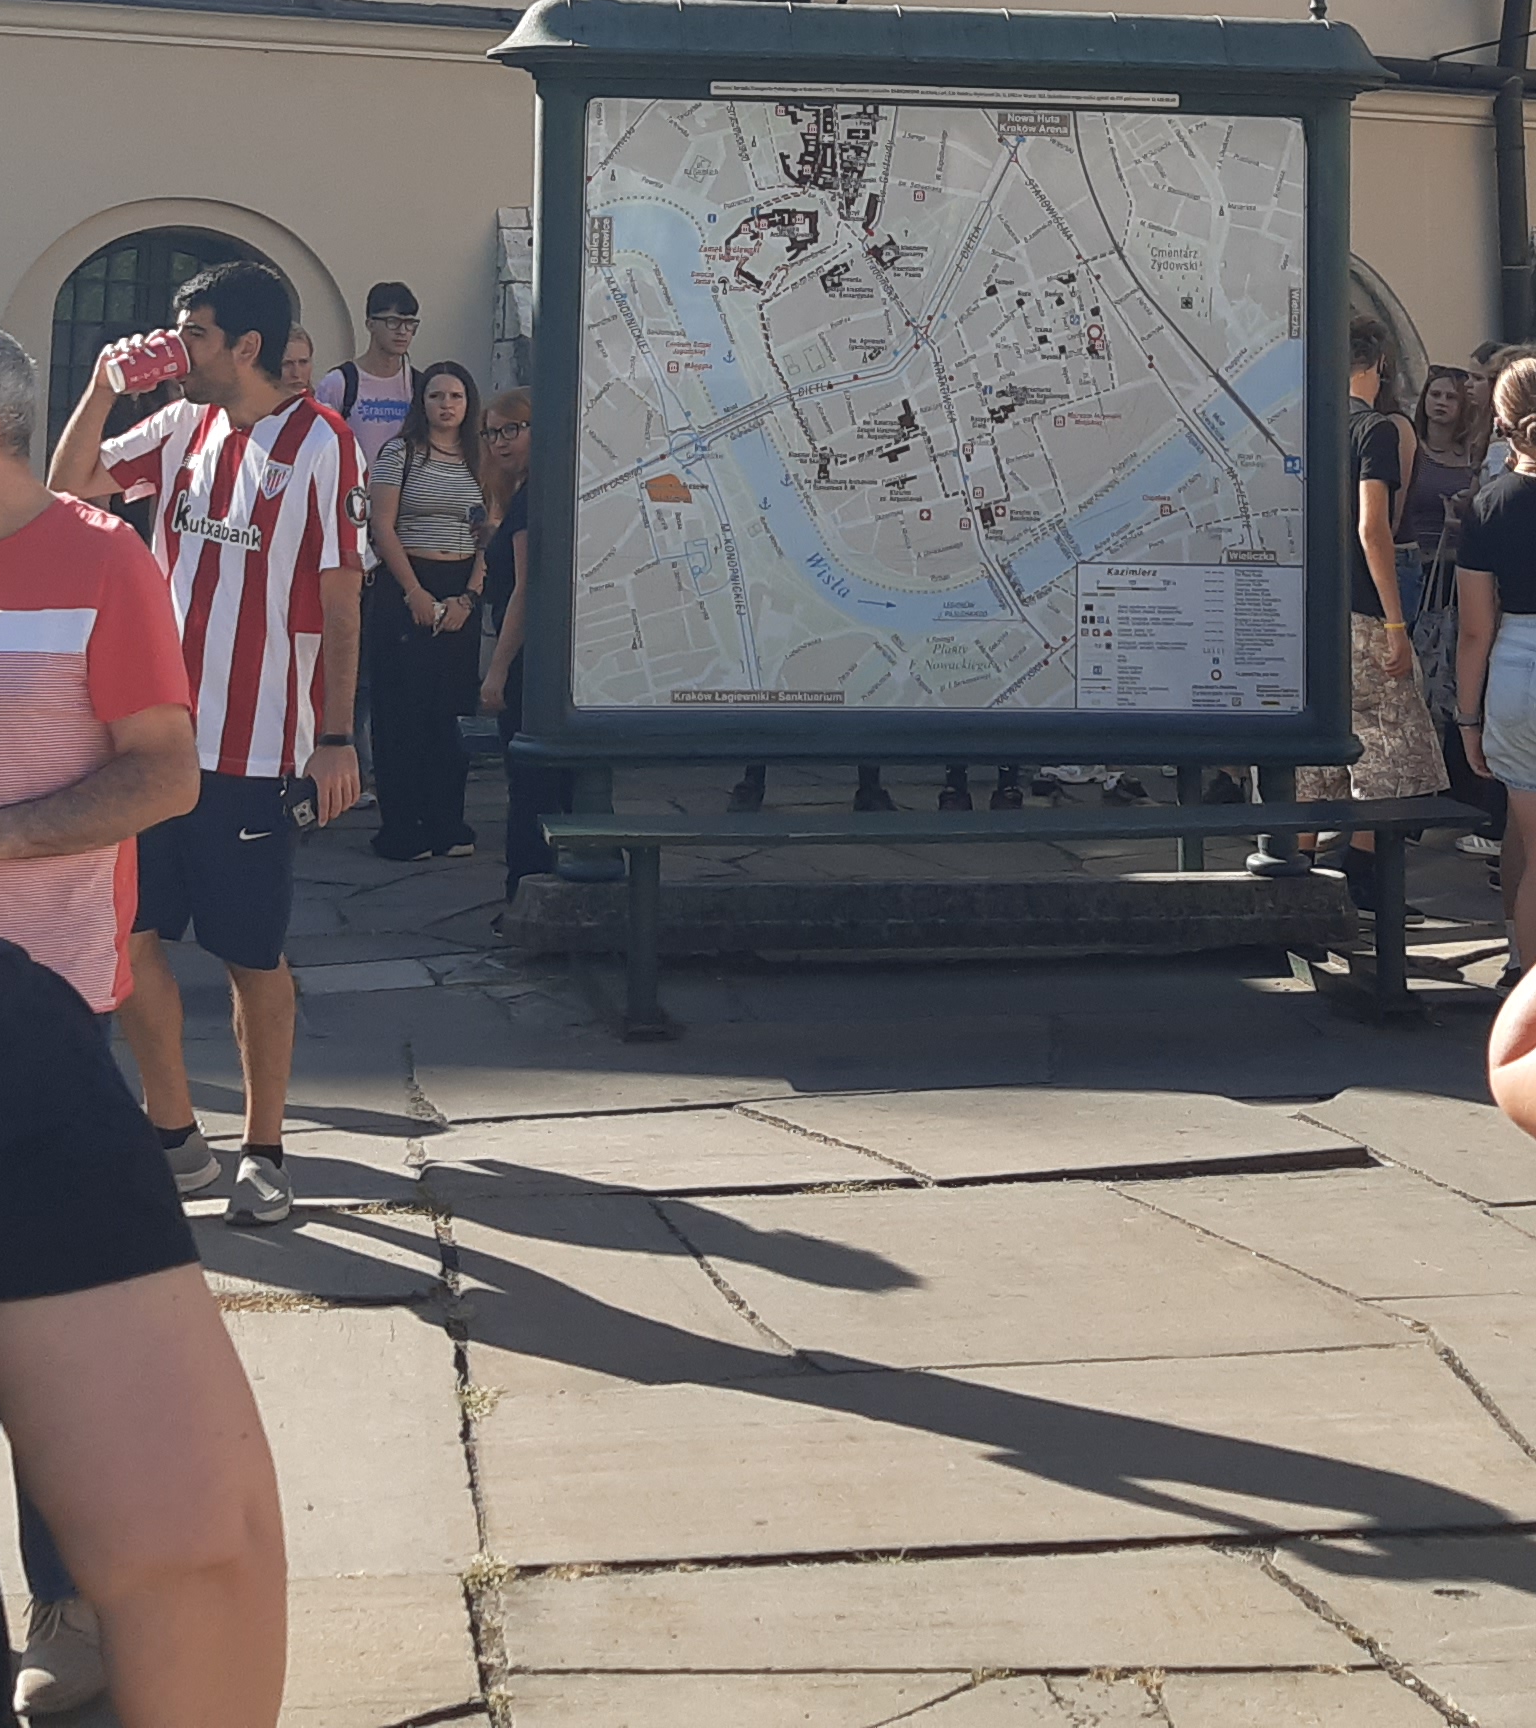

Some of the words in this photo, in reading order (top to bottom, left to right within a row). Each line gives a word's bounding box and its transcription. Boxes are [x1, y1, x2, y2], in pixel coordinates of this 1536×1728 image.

[1007, 114, 1034, 123] Nowa
[1037, 114, 1060, 123] Huta
[999, 124, 1036, 133] Kraków
[1039, 126, 1068, 134] Arena
[600, 218, 611, 264] Katowice
[1151, 247, 1198, 258] Cmentarz
[1229, 552, 1275, 561] Wieliczka
[1107, 568, 1157, 577] Kazimierz
[933, 645, 968, 654] Planty
[715, 693, 769, 703] Łagiewniki
[779, 693, 842, 701] Sanktuarium
